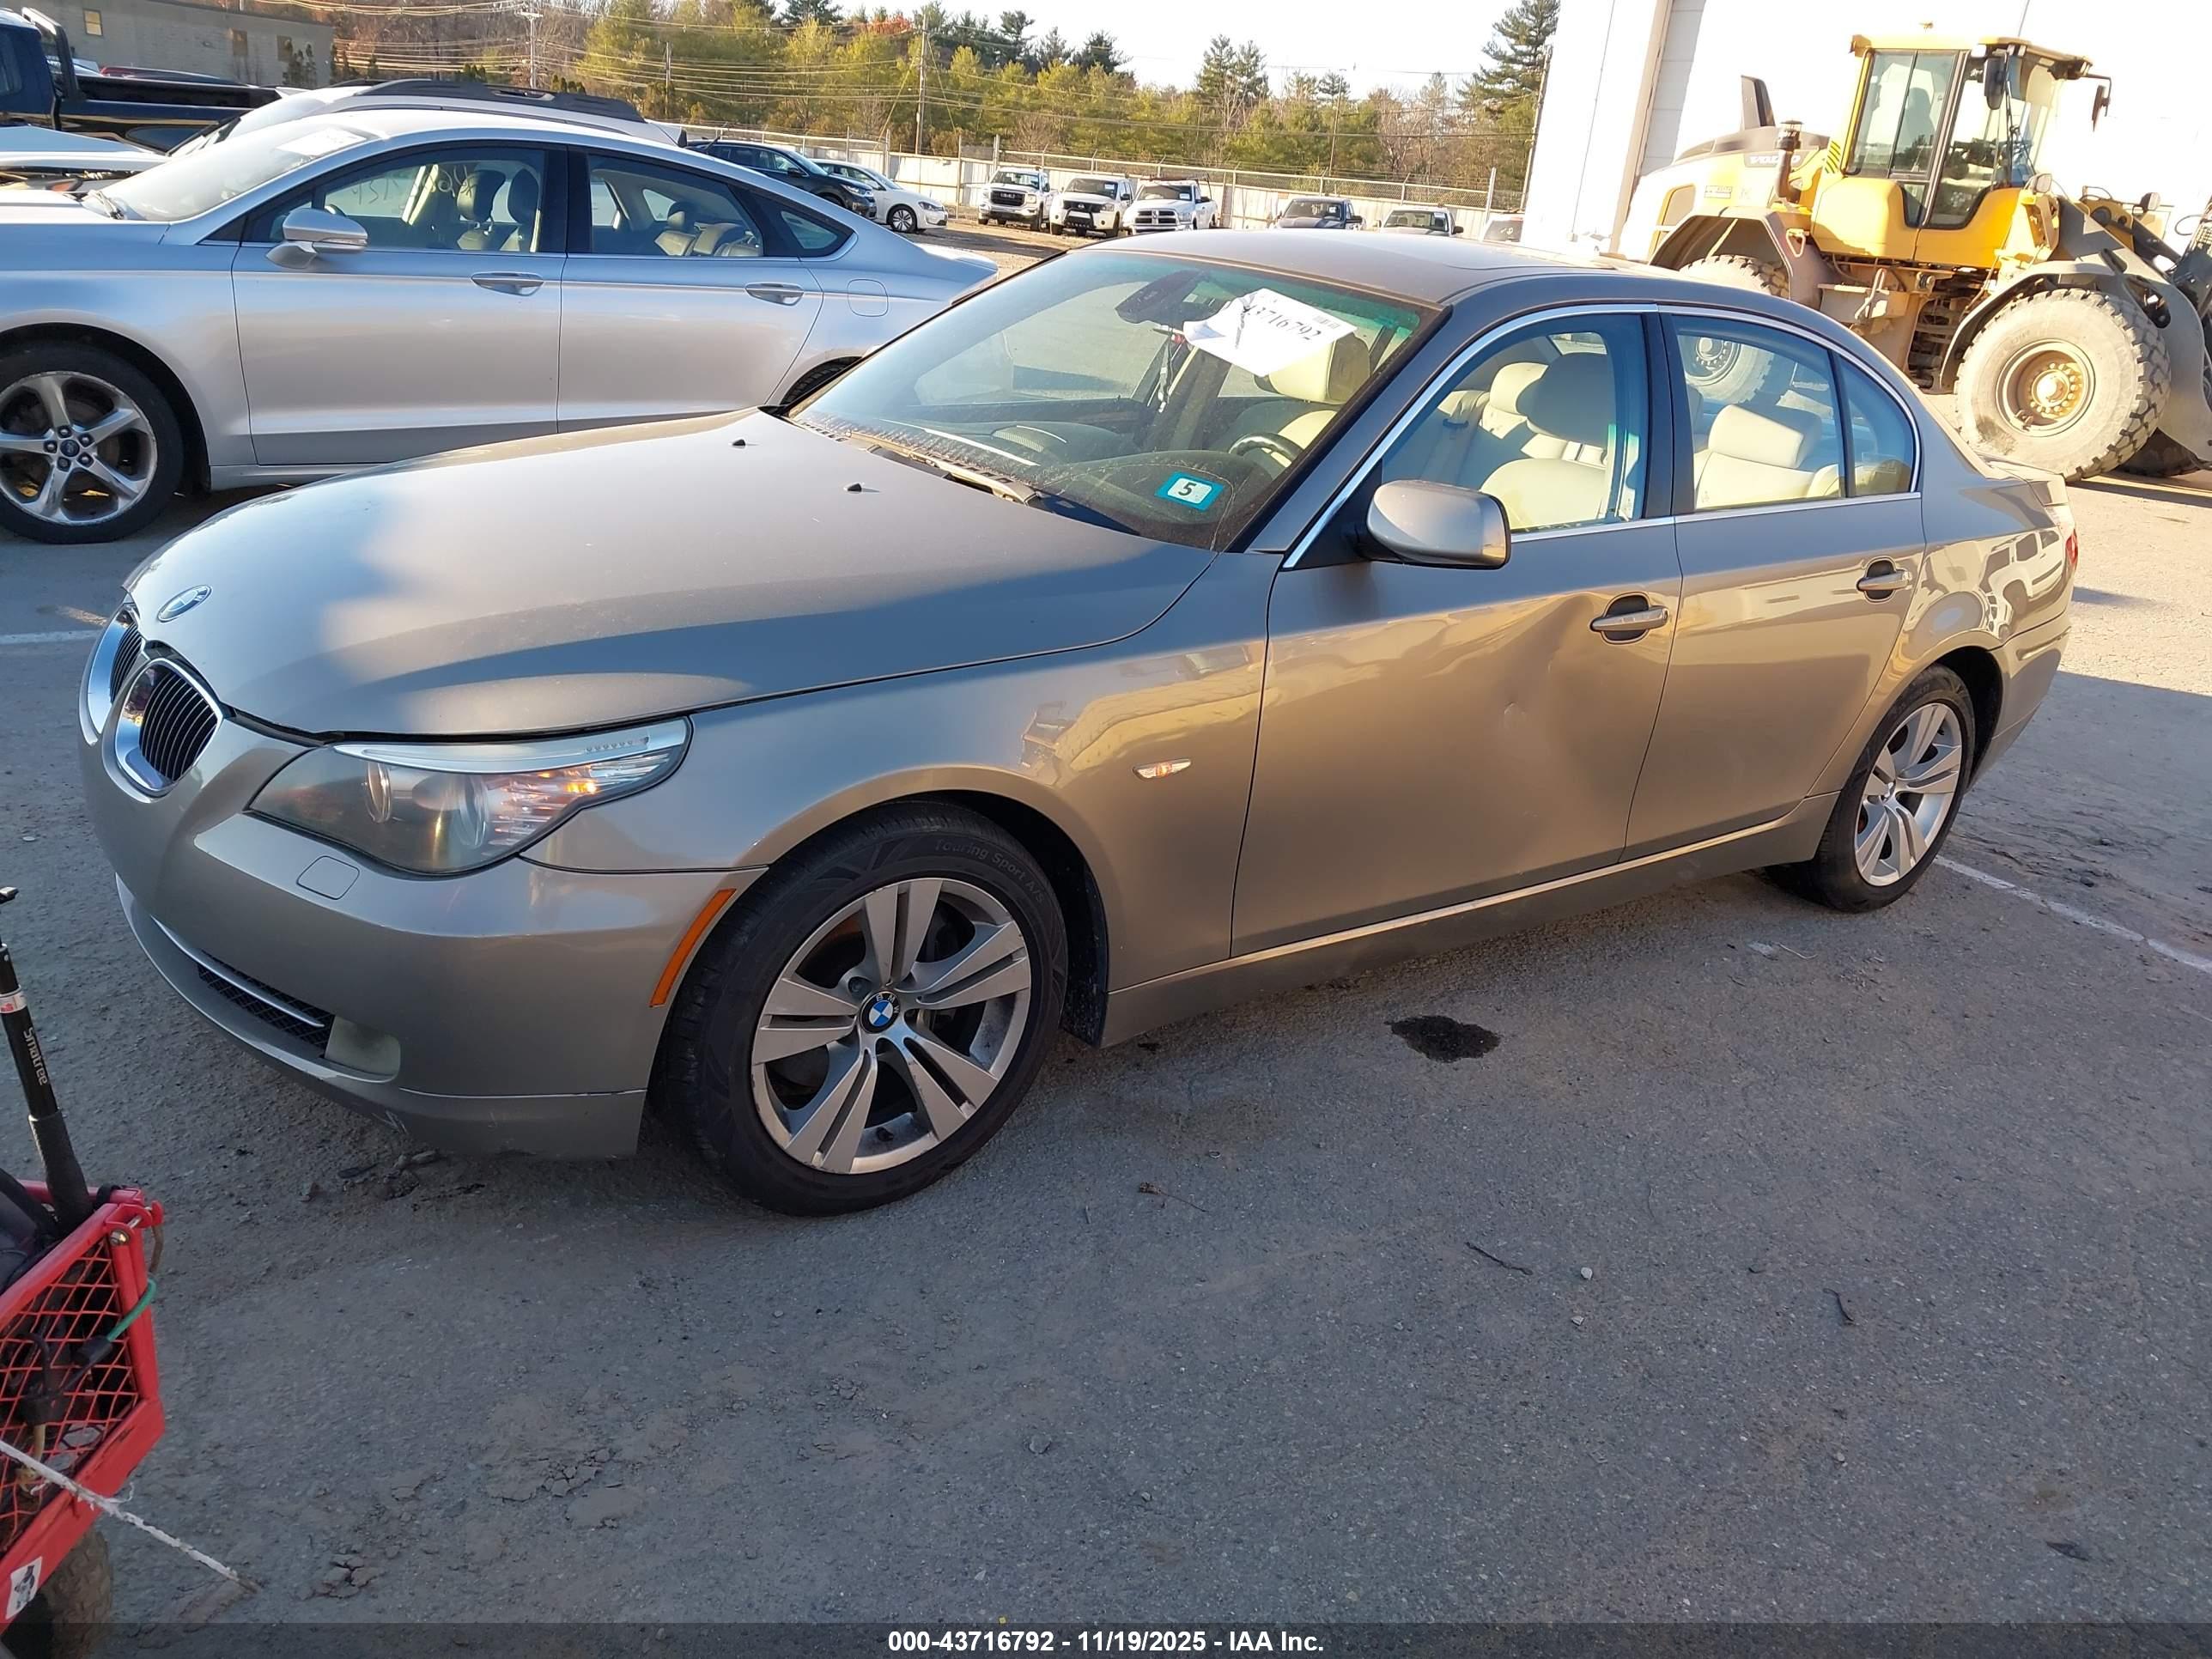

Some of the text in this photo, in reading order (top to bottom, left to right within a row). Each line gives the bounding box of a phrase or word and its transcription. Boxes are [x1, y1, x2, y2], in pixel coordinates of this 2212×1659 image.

[1178, 482, 1197, 496] 5
[992, 853, 1025, 880] Sport
[23, 1027, 47, 1085] Smatree
